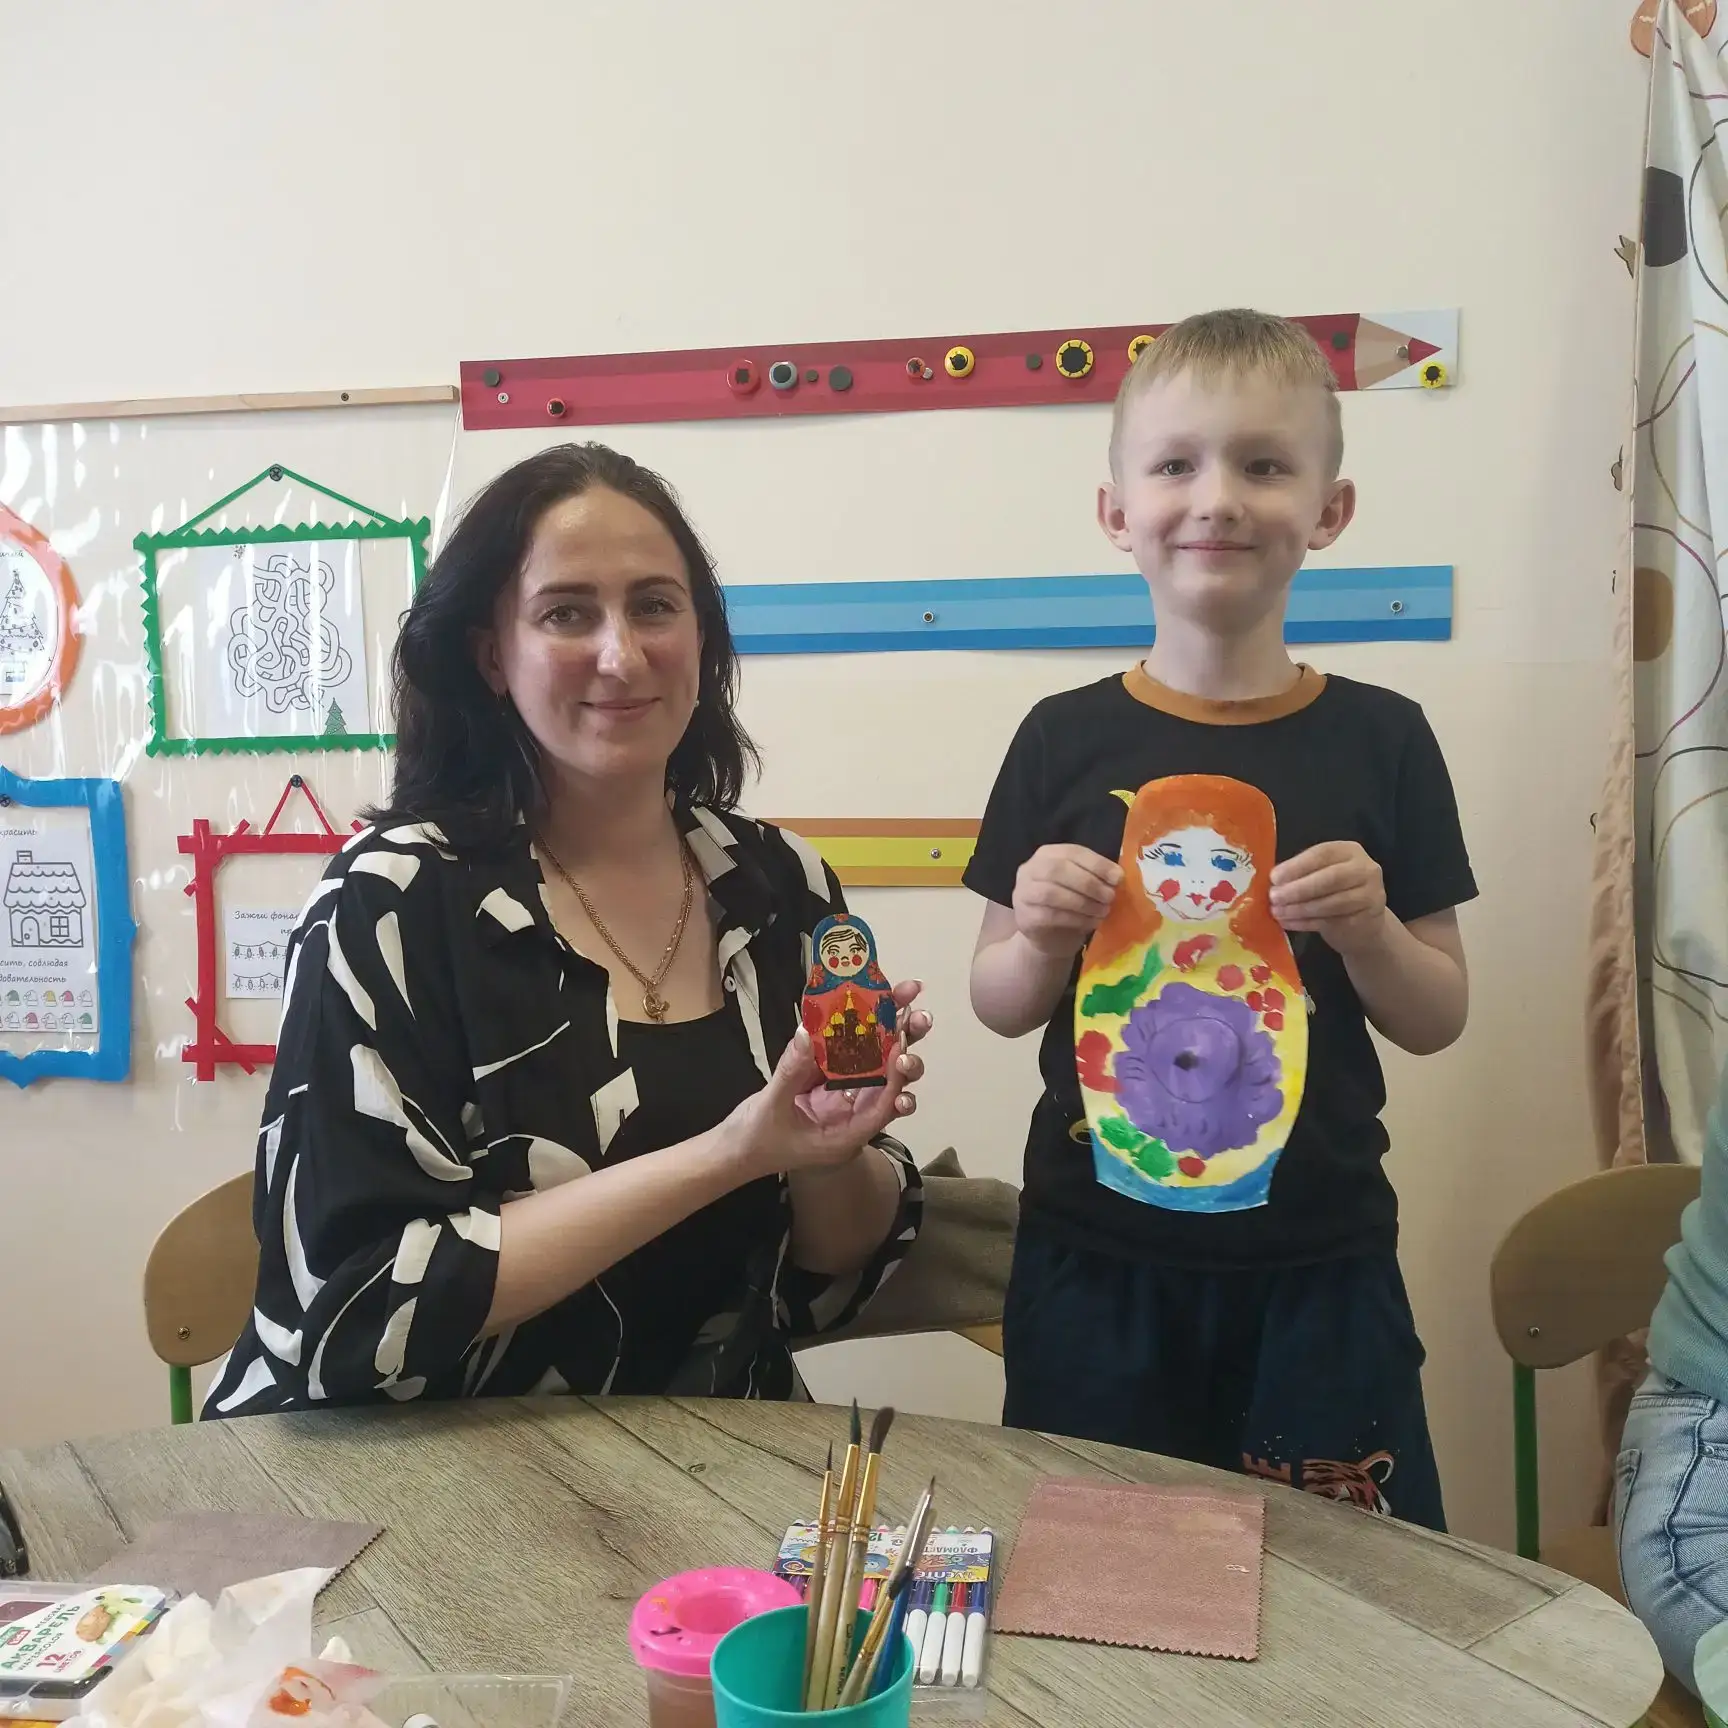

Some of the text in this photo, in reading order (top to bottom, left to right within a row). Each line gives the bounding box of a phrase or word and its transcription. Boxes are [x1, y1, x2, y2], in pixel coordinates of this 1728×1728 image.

[234, 910, 268, 920] Зажги
[28, 958, 68, 967] соблюдая
[924, 1546, 978, 1554] ФЛОМАСТ
[1, 1605, 80, 1669] АКВАРЕЛЬ
[17, 1632, 63, 1671] WATERCOLOR
[36, 1653, 66, 1668] 12
[53, 1649, 82, 1673] ЦВЕТОВ
